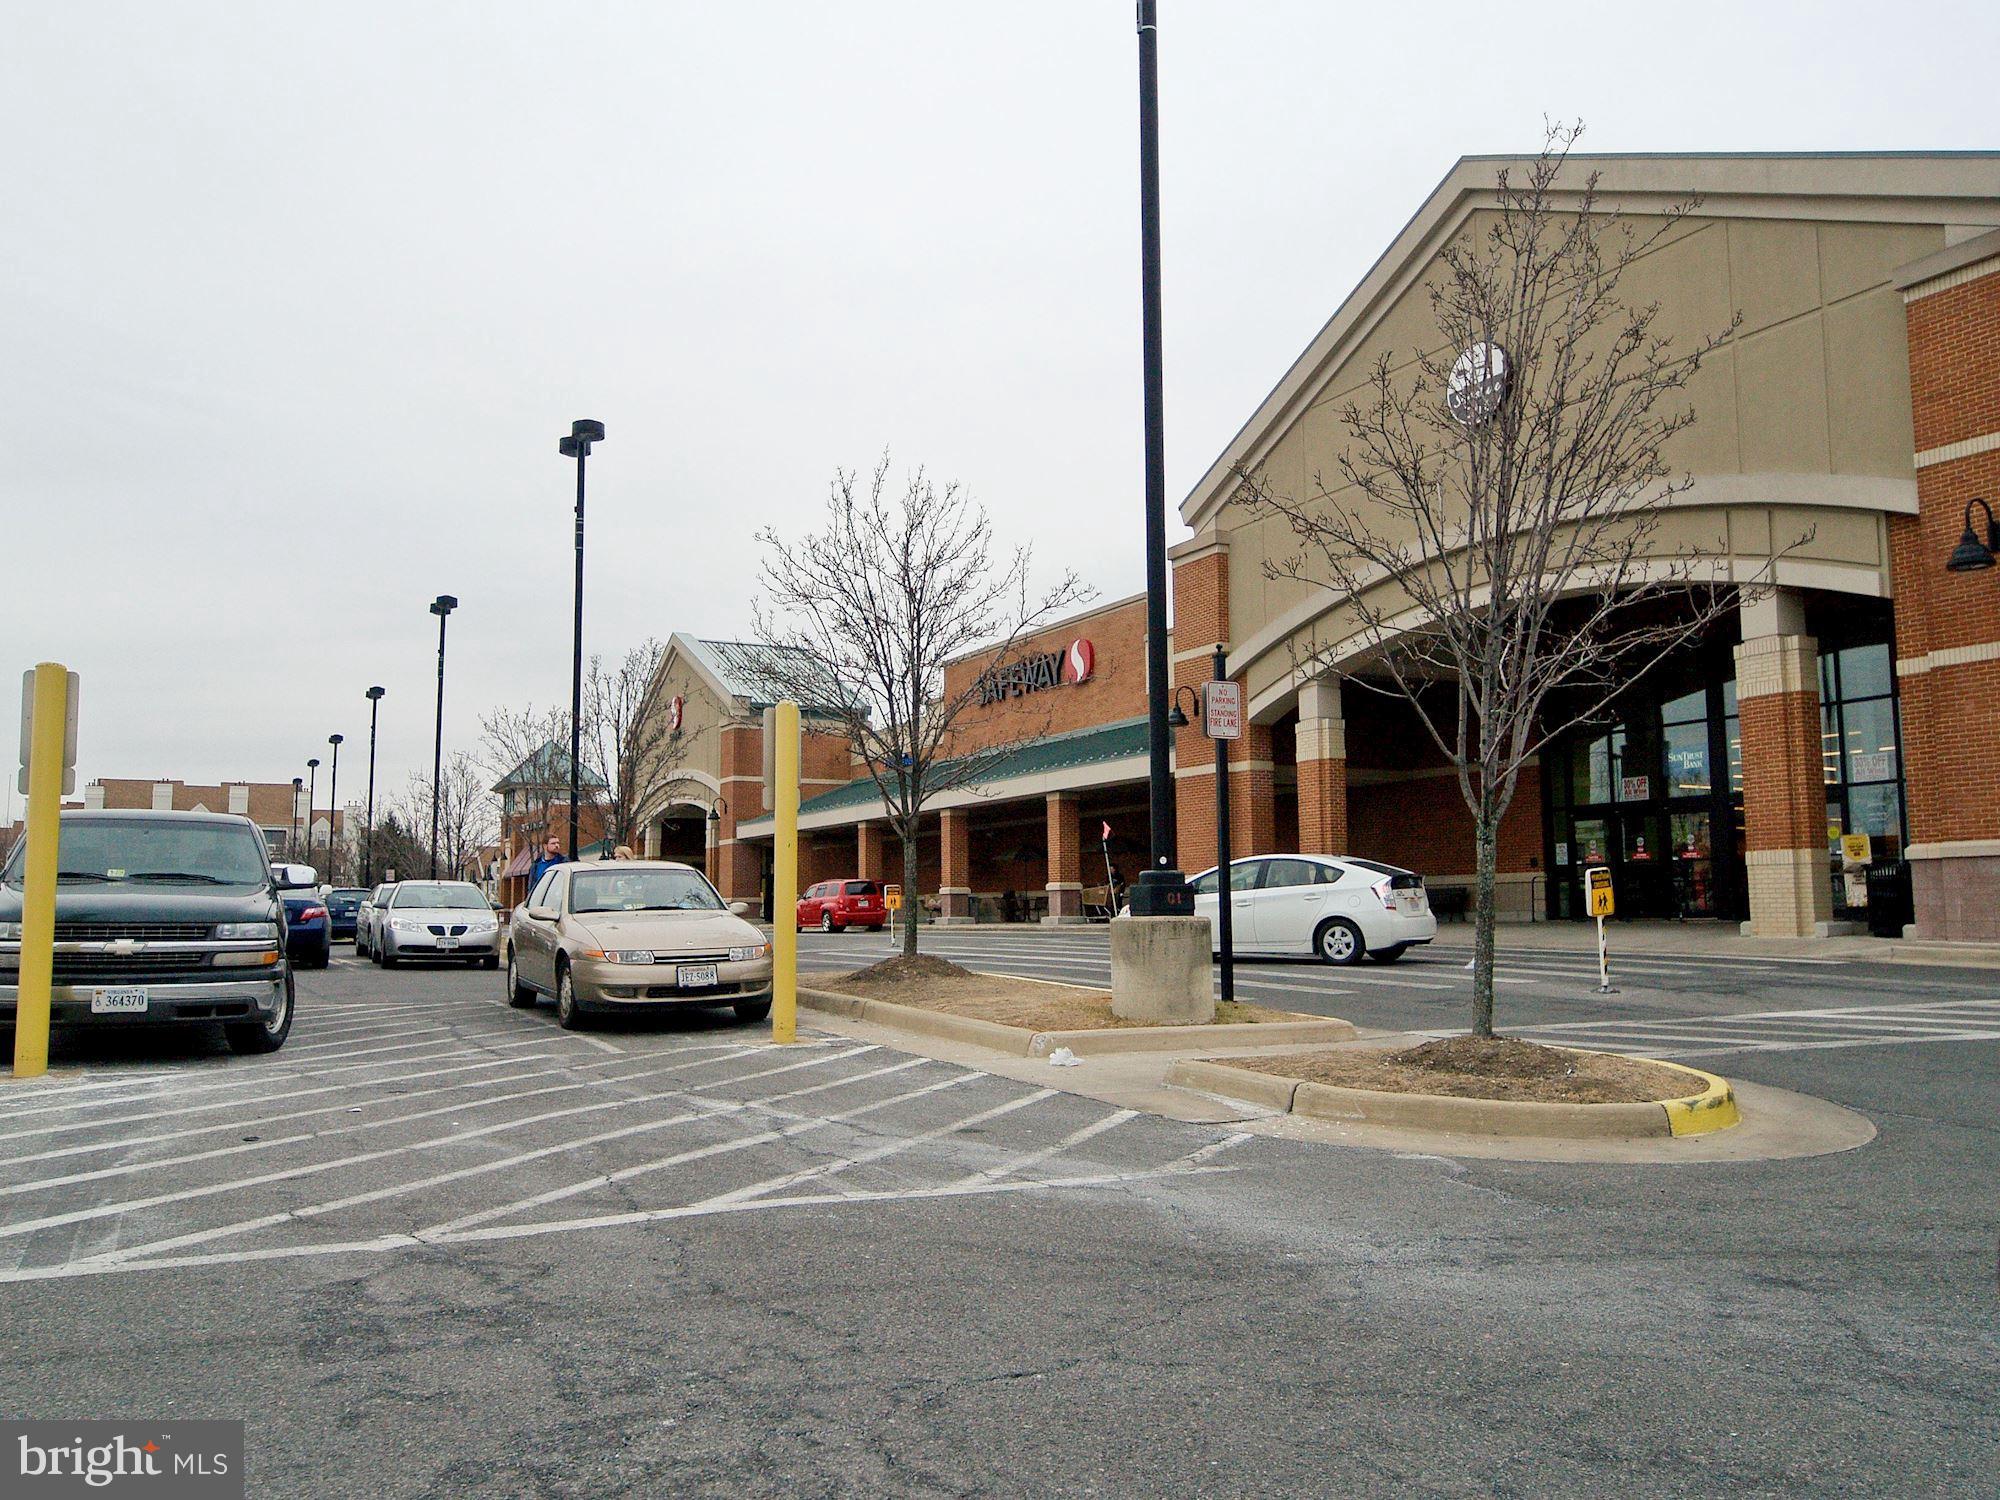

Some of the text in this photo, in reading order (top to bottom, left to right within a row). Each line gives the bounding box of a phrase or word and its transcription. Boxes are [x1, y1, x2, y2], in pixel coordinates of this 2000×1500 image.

[1218, 689, 1228, 697] NO
[1211, 709, 1237, 718] STANDING
[1211, 718, 1237, 728] FIRE LANE
[1637, 777, 1647, 788] OFF
[106, 995, 145, 1006] 364370
